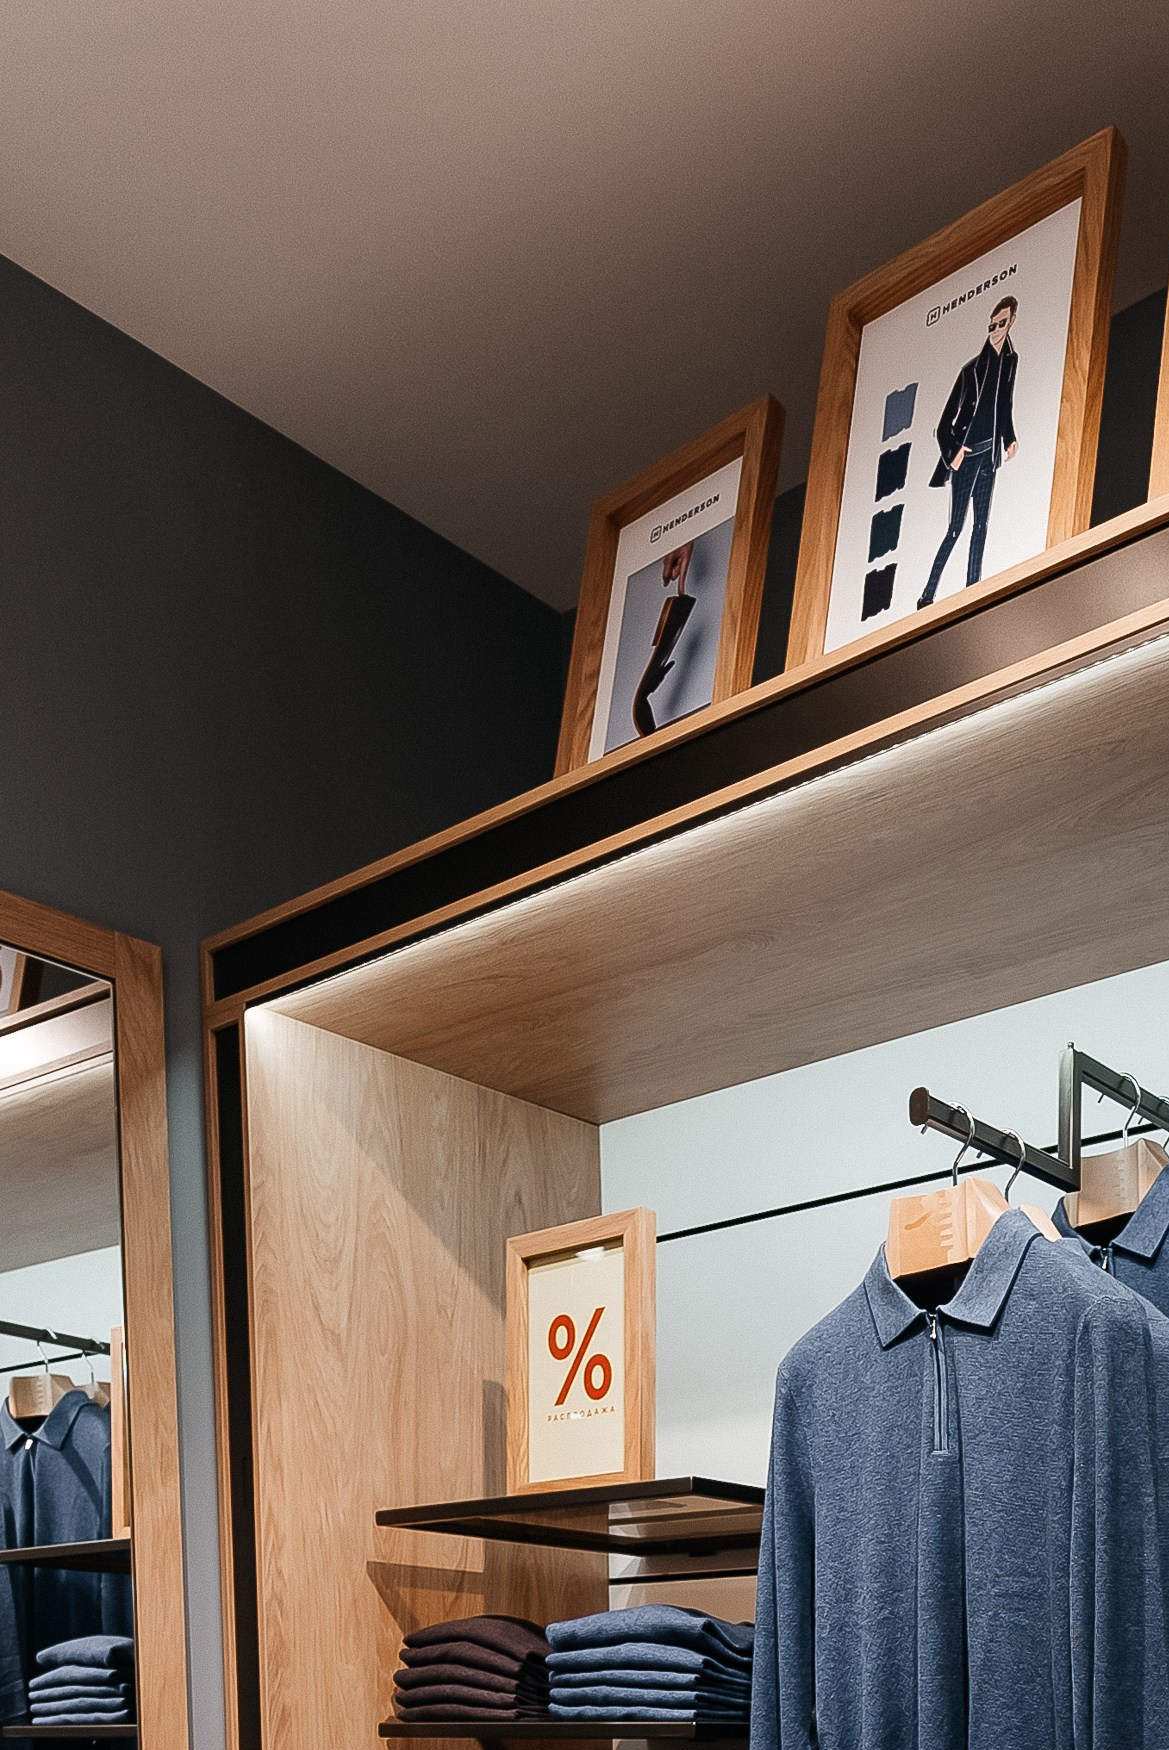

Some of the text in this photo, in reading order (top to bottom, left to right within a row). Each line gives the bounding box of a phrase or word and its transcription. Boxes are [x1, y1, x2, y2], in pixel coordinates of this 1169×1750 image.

[942, 263, 1018, 315] HENDERSON
[662, 493, 720, 534] HENDERSON
[548, 1306, 612, 1406] %
[547, 1405, 615, 1422] РАСПОДАЖА
